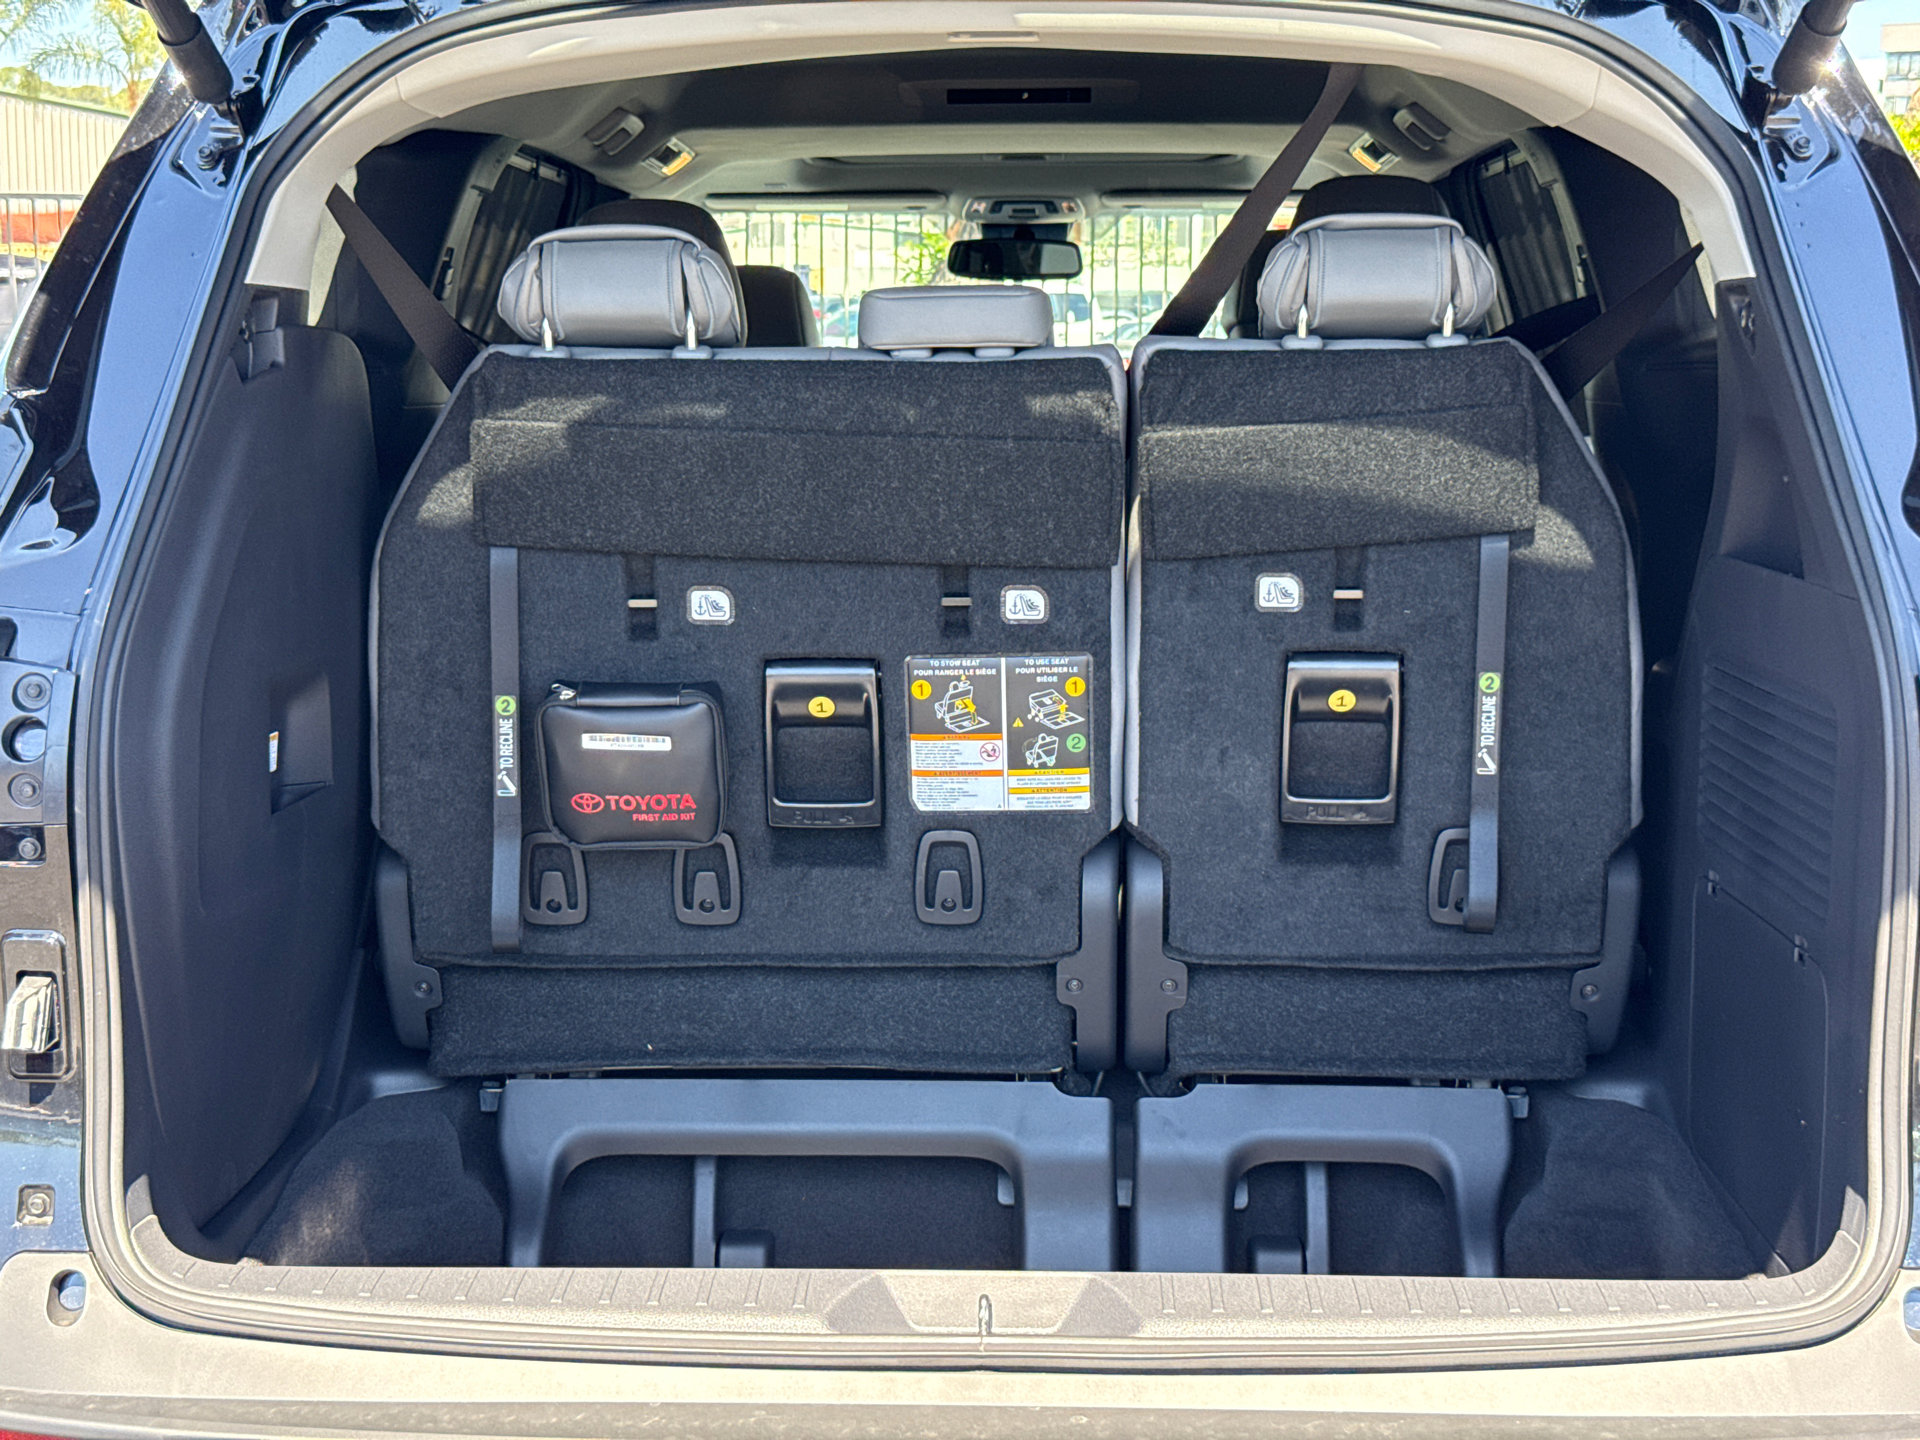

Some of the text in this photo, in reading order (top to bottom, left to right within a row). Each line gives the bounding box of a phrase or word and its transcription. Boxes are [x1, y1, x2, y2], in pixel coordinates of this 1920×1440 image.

[1485, 676, 1495, 690] 2
[501, 699, 511, 713] 2
[815, 702, 827, 713] 1
[1335, 696, 1347, 707] 1
[1480, 695, 1496, 747] TO RECLINE
[499, 718, 514, 769] TO RECLINE
[1071, 736, 1081, 749] 2
[605, 793, 697, 811] TOYOTA
[632, 812, 696, 822] FIRST AID KIT
[1306, 806, 1346, 821] PULL
